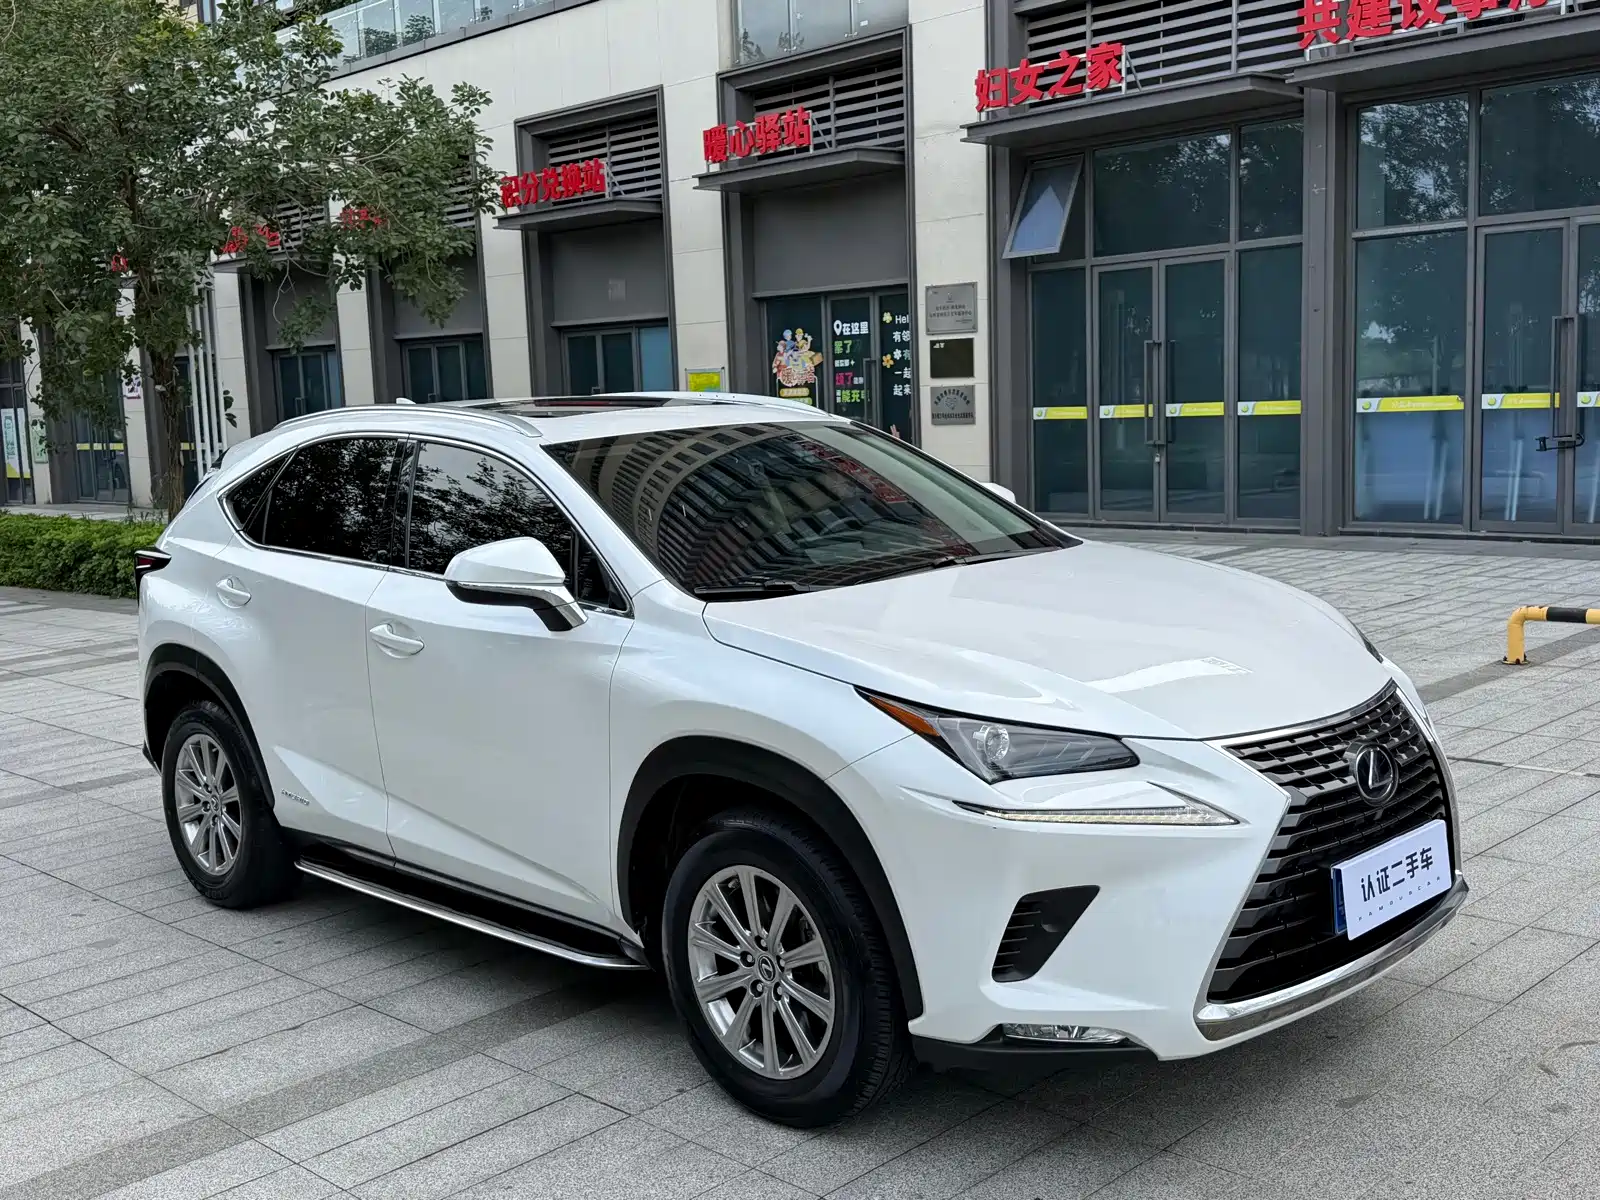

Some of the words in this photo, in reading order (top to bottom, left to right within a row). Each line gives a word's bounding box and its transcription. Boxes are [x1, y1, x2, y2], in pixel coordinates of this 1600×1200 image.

[975, 42, 1124, 112] 妇女之家
[703, 105, 811, 164] 暖心驿站
[1361, 847, 1434, 902] 认证二手车
